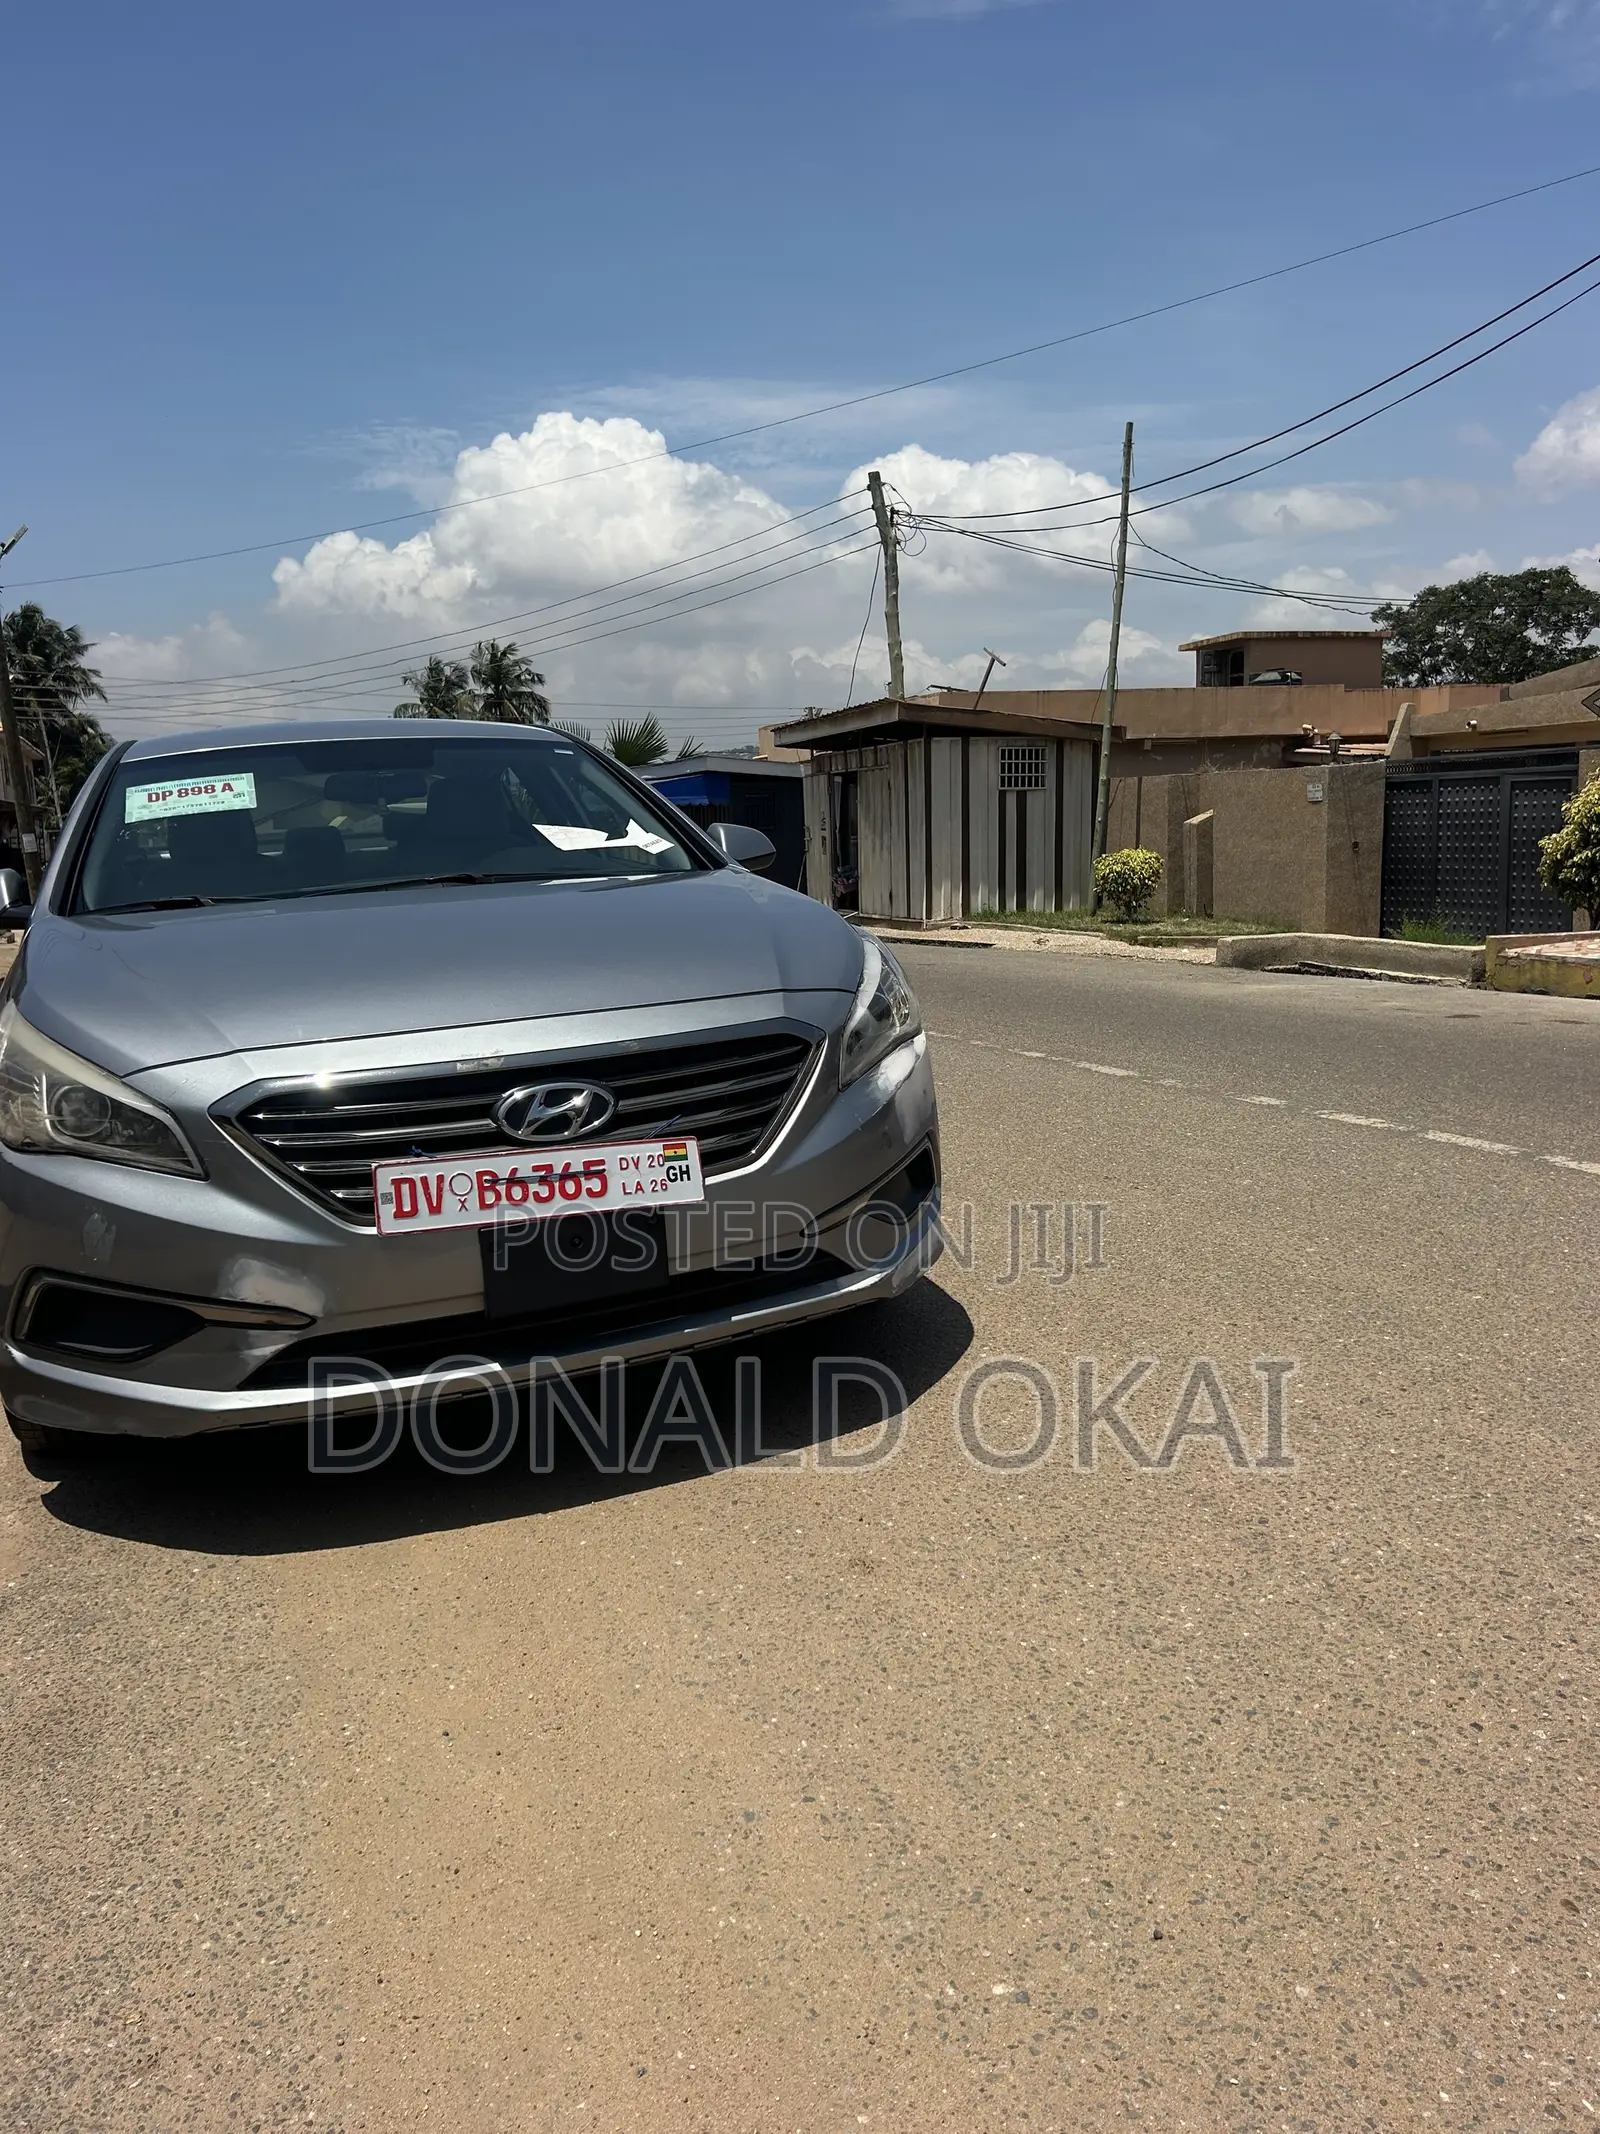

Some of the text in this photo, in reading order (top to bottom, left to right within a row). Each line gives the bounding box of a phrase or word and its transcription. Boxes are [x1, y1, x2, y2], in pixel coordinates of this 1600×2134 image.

[147, 791, 173, 803] DP
[177, 785, 216, 798] 898
[221, 782, 234, 793] A
[618, 1153, 665, 1171] DV 20
[666, 1164, 691, 1183] GH
[391, 1174, 444, 1219] DV
[475, 1158, 608, 1210] B6365
[621, 1178, 668, 1195] LA 26
